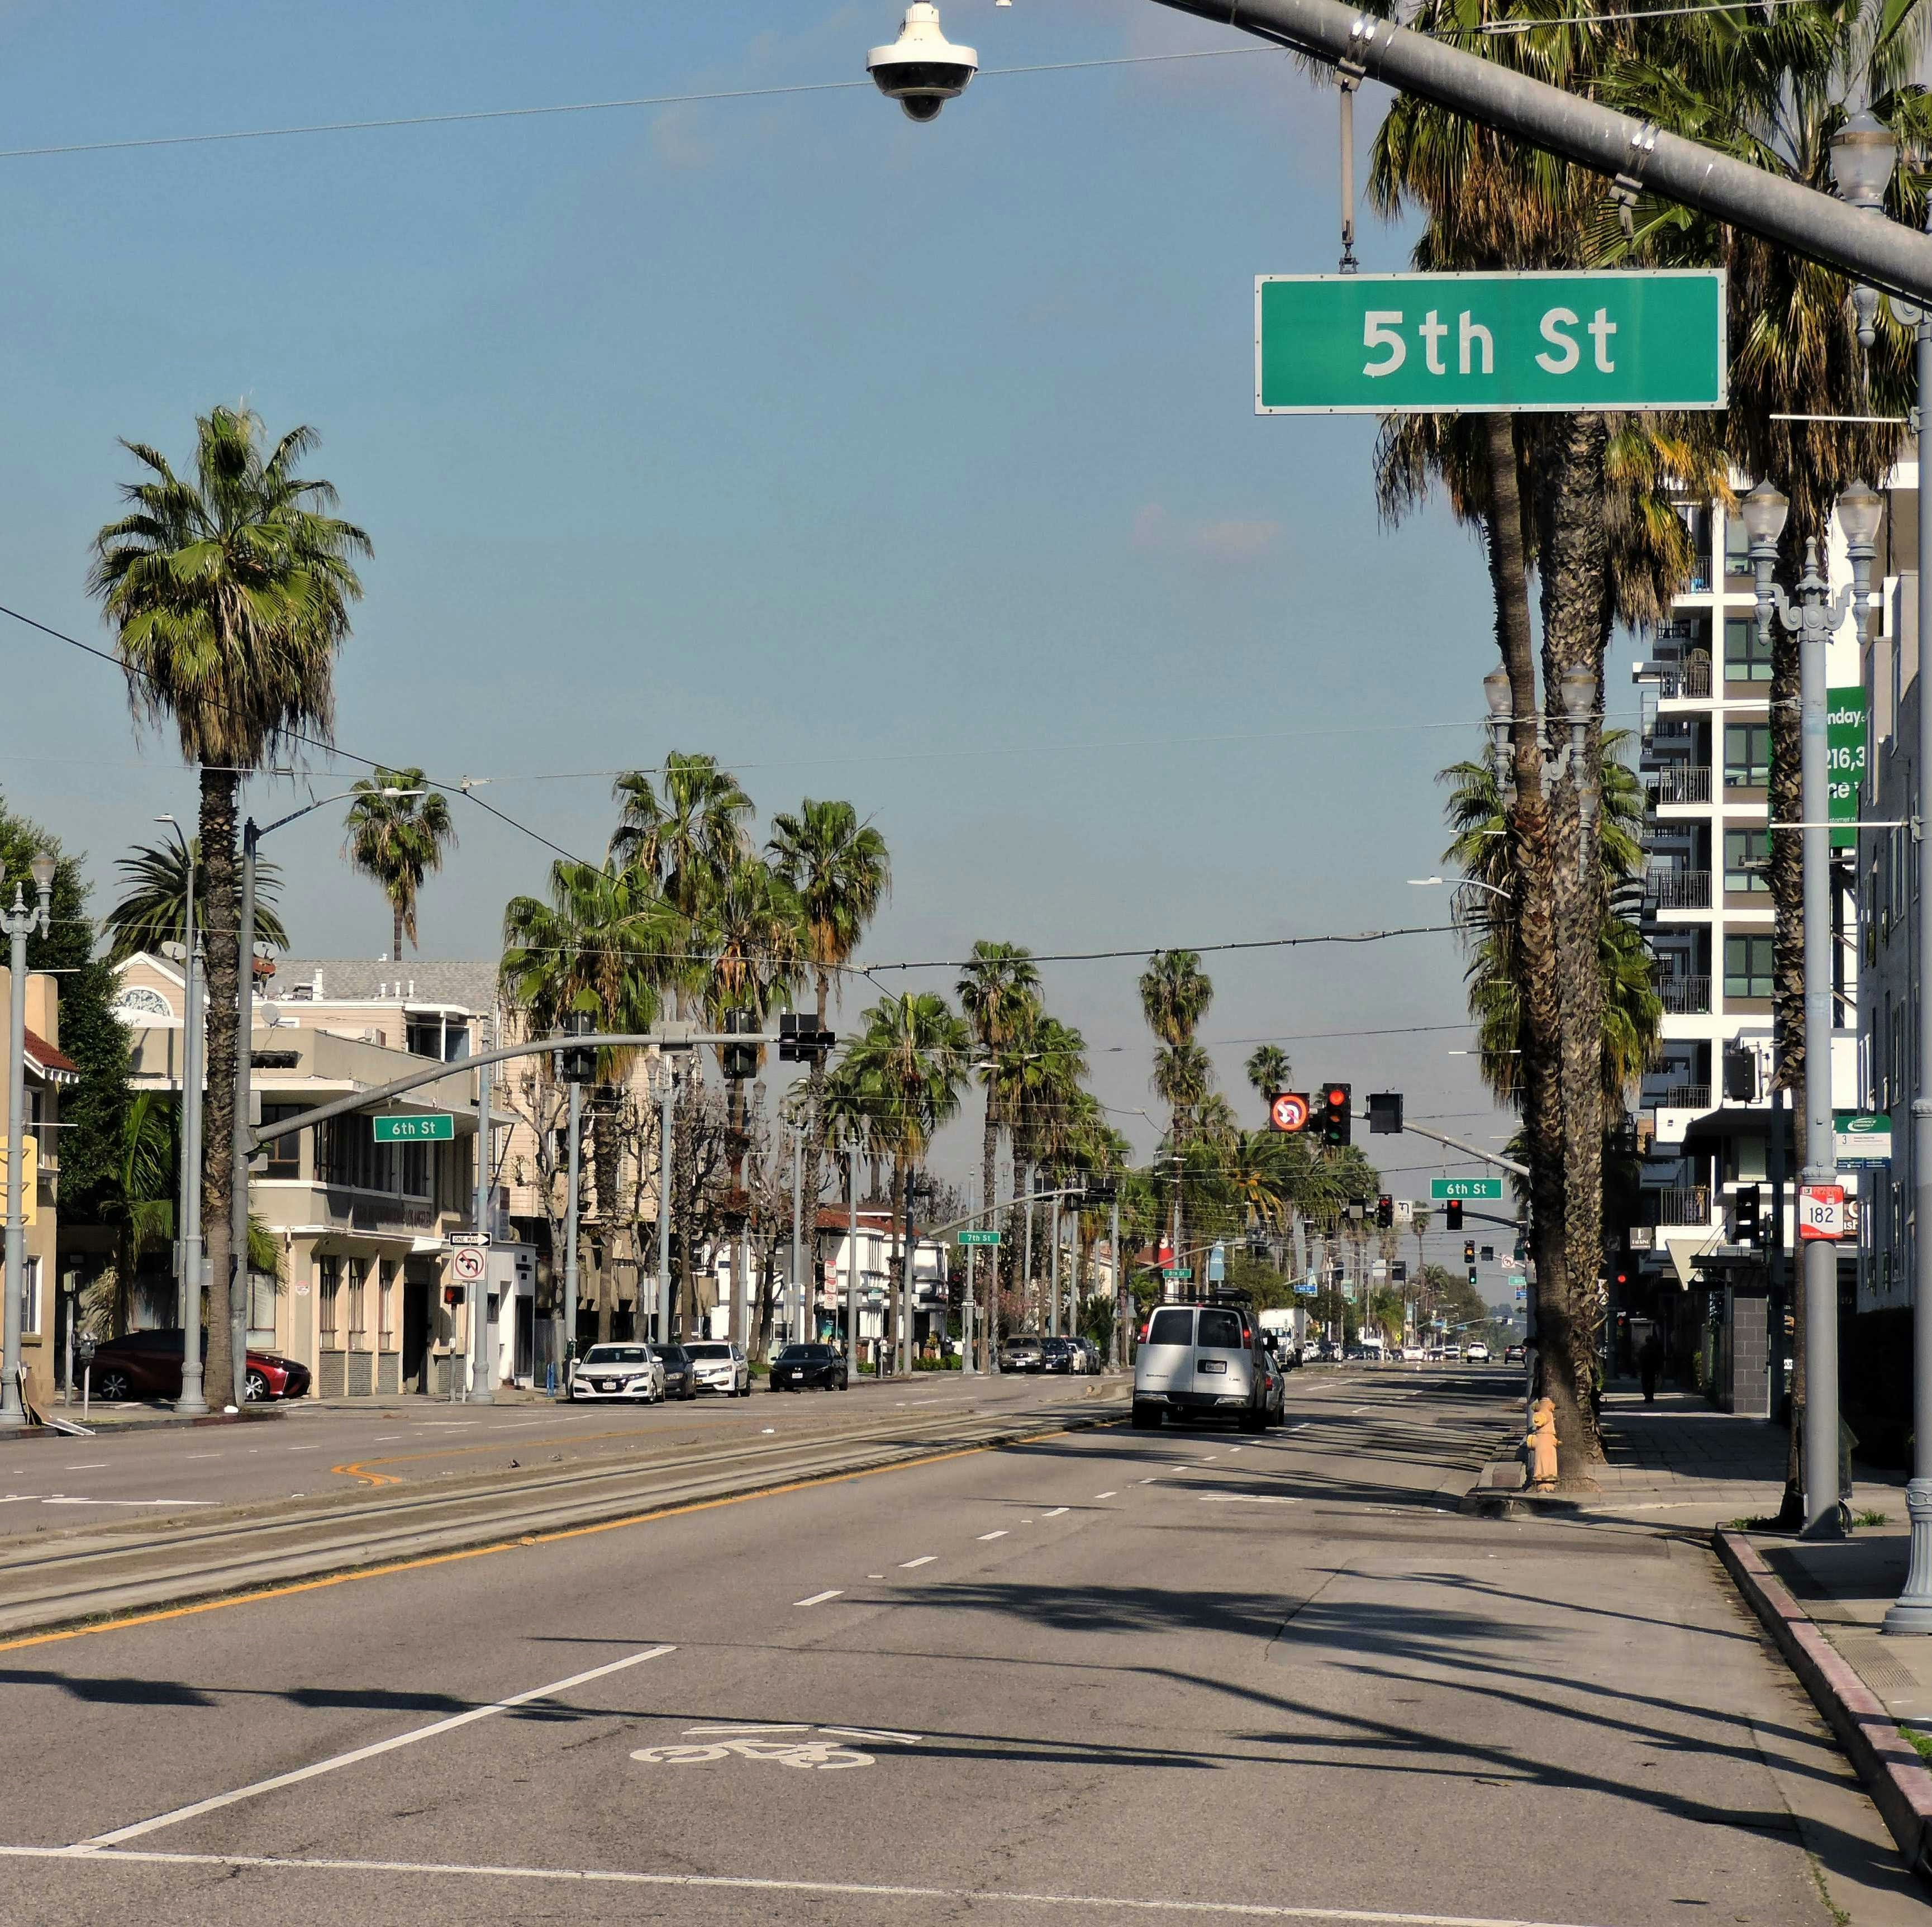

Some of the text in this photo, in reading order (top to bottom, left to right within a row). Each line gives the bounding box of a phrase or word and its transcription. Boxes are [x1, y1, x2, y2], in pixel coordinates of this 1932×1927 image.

[1362, 307, 1617, 378] 5th St
[392, 1121, 436, 1135] 6th St
[1842, 1135, 1847, 1145] 3
[1446, 1183, 1487, 1195] 6th St
[1810, 1207, 1834, 1224] 182
